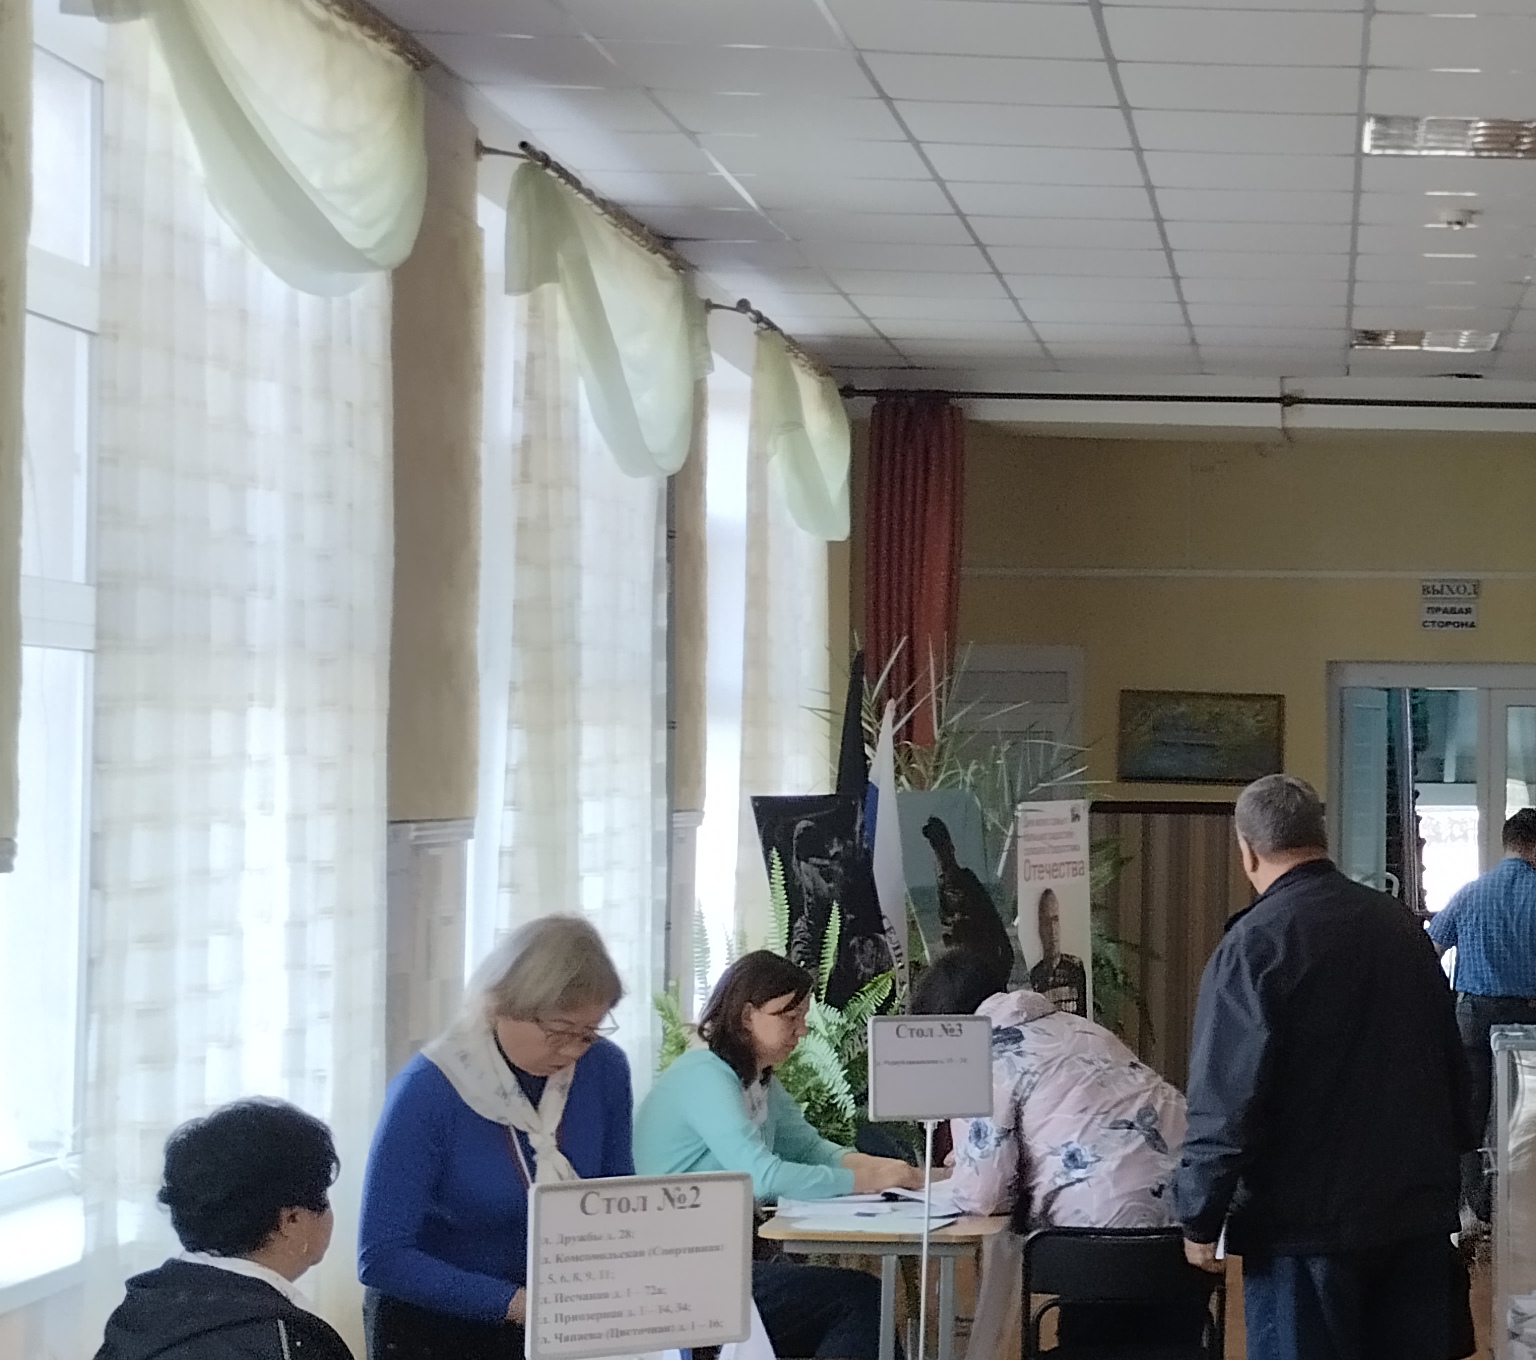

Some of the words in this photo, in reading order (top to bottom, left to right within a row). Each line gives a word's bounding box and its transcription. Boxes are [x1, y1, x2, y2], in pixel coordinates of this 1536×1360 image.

[1421, 583, 1479, 596] ВЫХОД
[1426, 606, 1473, 615] ПРАВАЯ
[1421, 620, 1476, 629] СТОРОНА
[1023, 858, 1085, 883] Отечества
[895, 1023, 934, 1040] Стол
[938, 1022, 964, 1039] №3
[579, 1190, 648, 1216] Стол
[656, 1185, 702, 1212] №2
